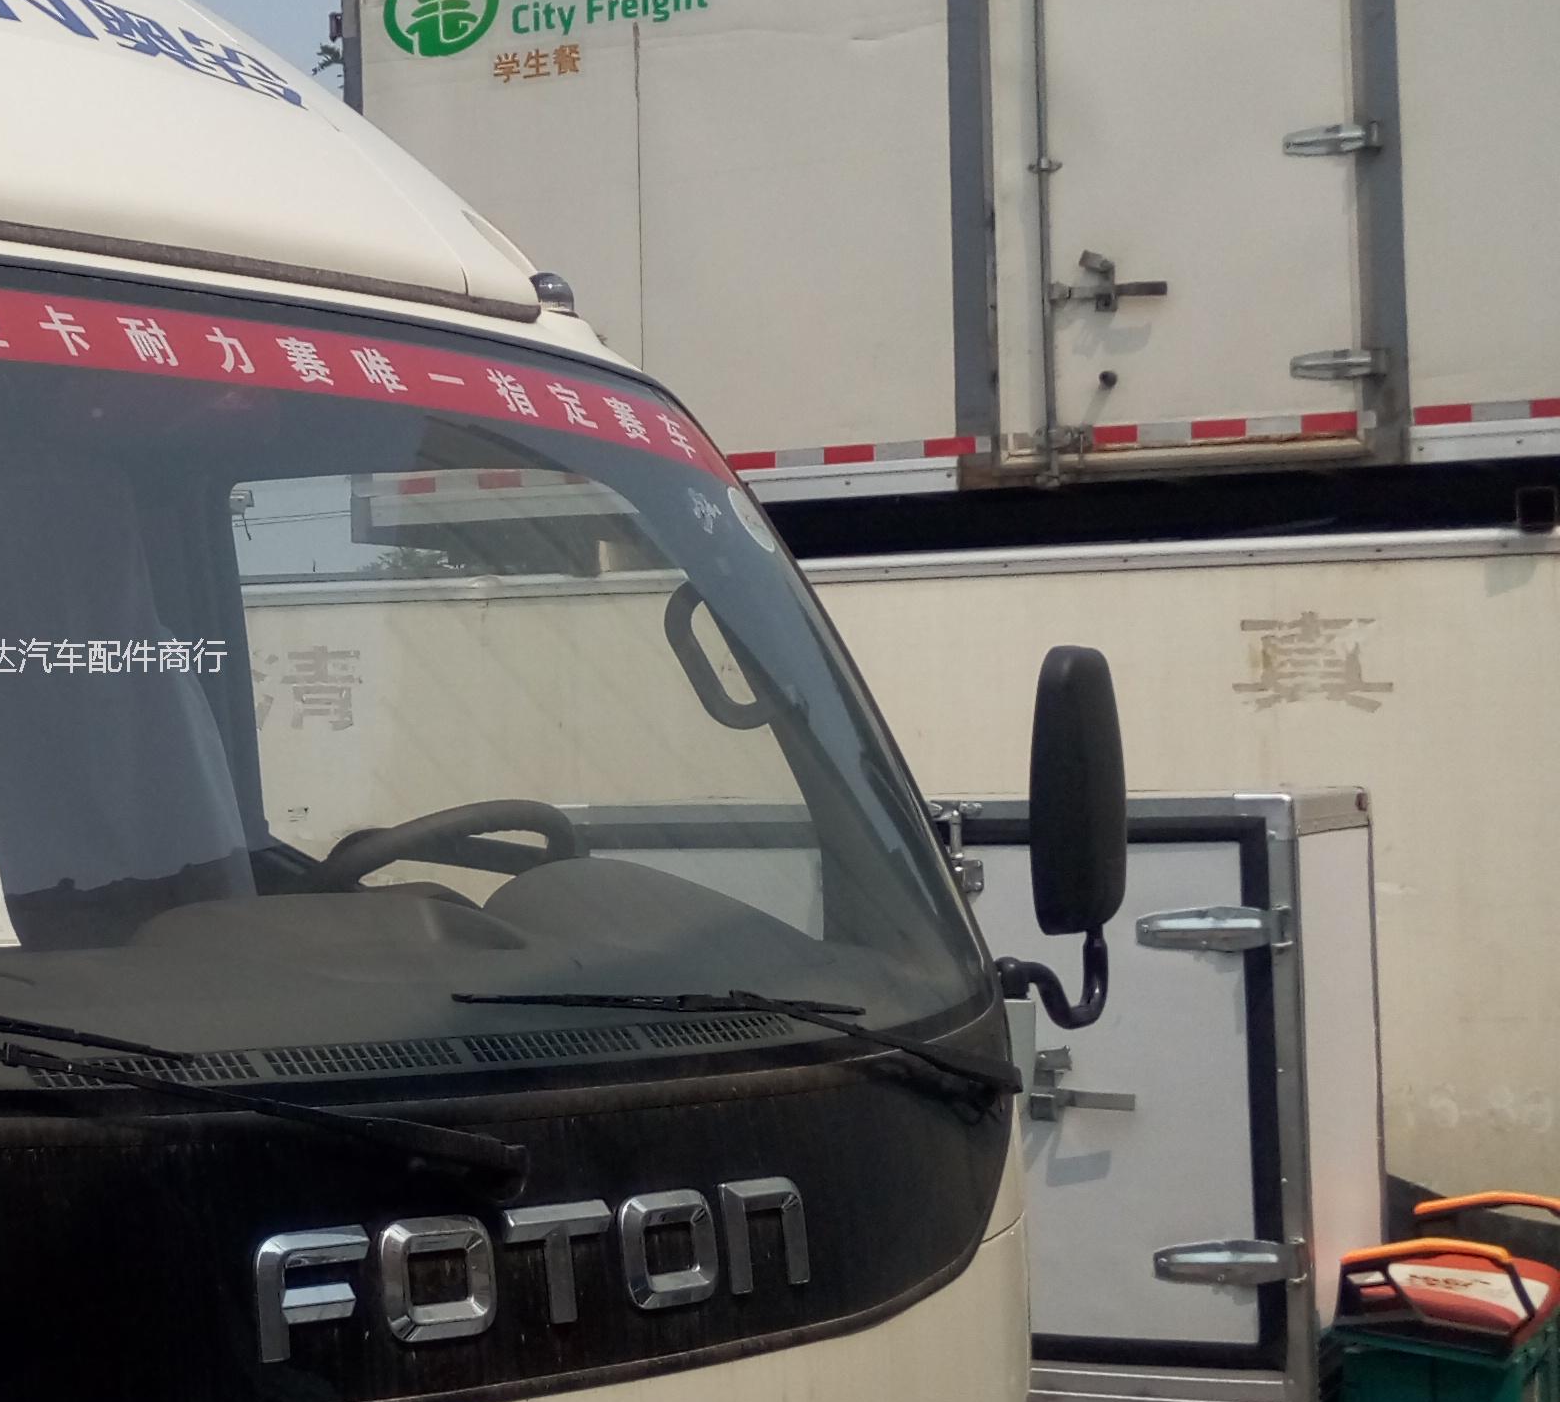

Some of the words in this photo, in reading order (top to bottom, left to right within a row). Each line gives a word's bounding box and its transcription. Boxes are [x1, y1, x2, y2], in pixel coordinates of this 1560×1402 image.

[511, 2, 575, 36] City
[492, 43, 583, 83] 学生餐
[252, 1175, 812, 1364] FOTON
